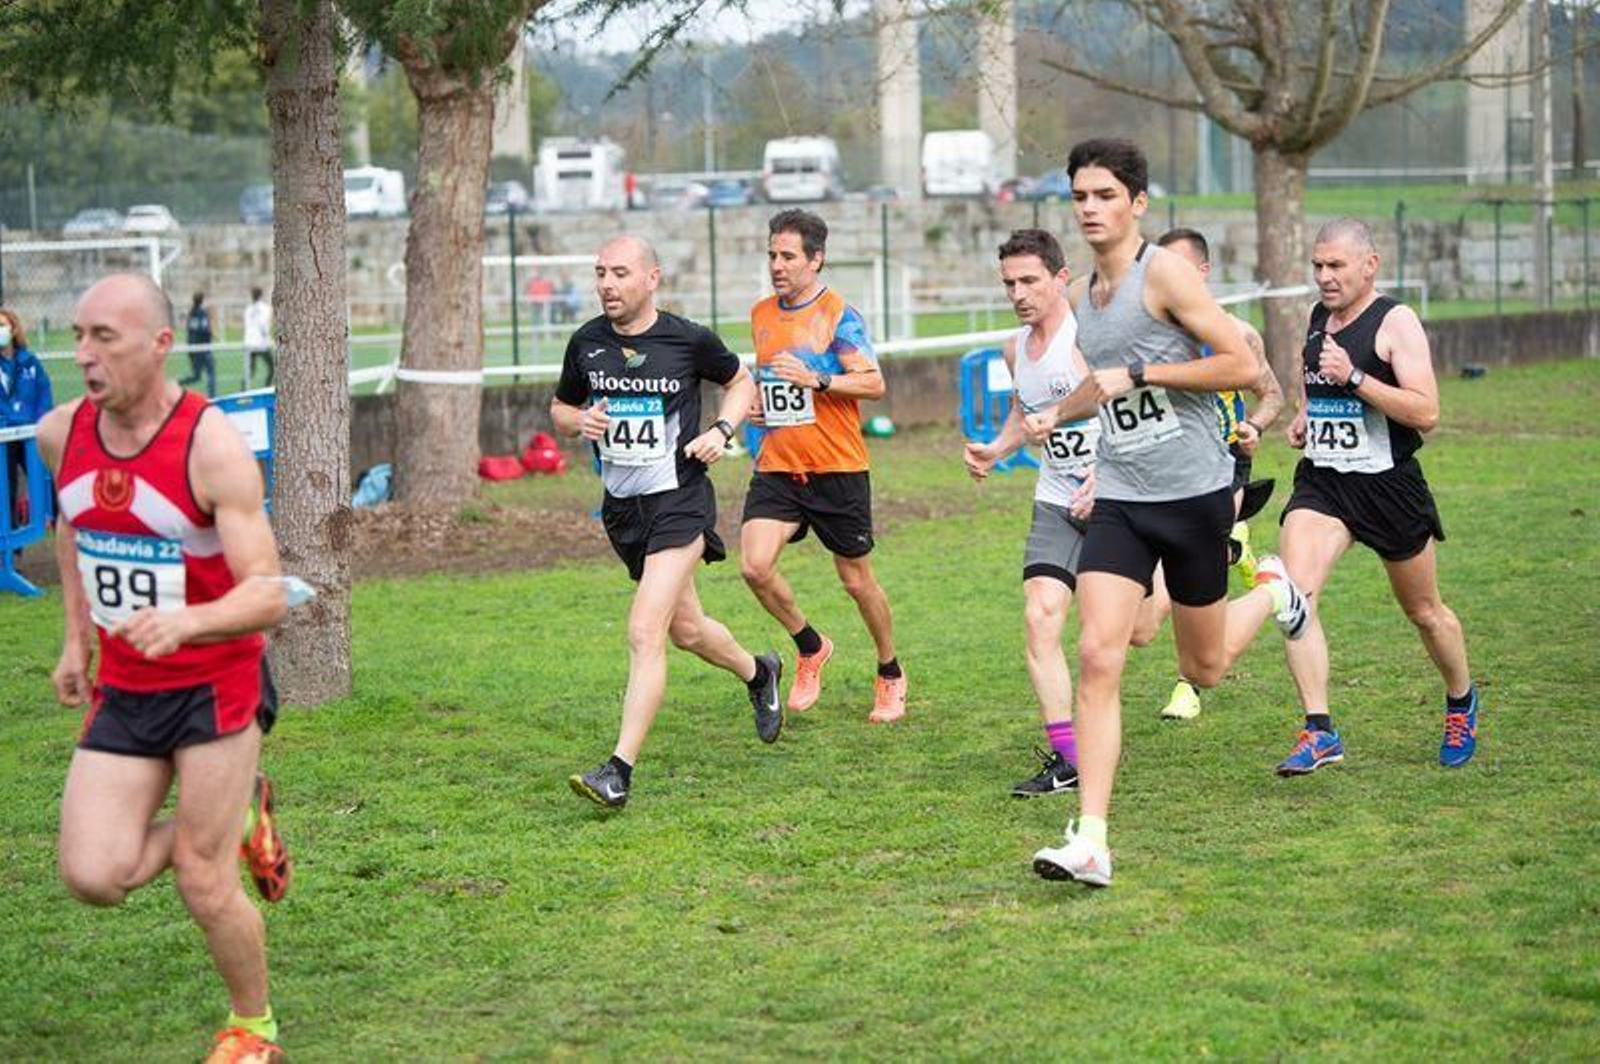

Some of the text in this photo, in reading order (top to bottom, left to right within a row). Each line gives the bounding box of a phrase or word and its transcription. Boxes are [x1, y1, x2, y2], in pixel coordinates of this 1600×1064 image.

[588, 370, 680, 393] Biocouto
[647, 400, 662, 413] 22
[764, 385, 805, 412] 163
[1103, 389, 1165, 434] 164
[1347, 401, 1362, 414] 22
[604, 419, 658, 449] 144
[1045, 431, 1091, 459] 152
[1310, 420, 1358, 449] 143
[158, 541, 181, 559] 22
[96, 565, 157, 610] 89
